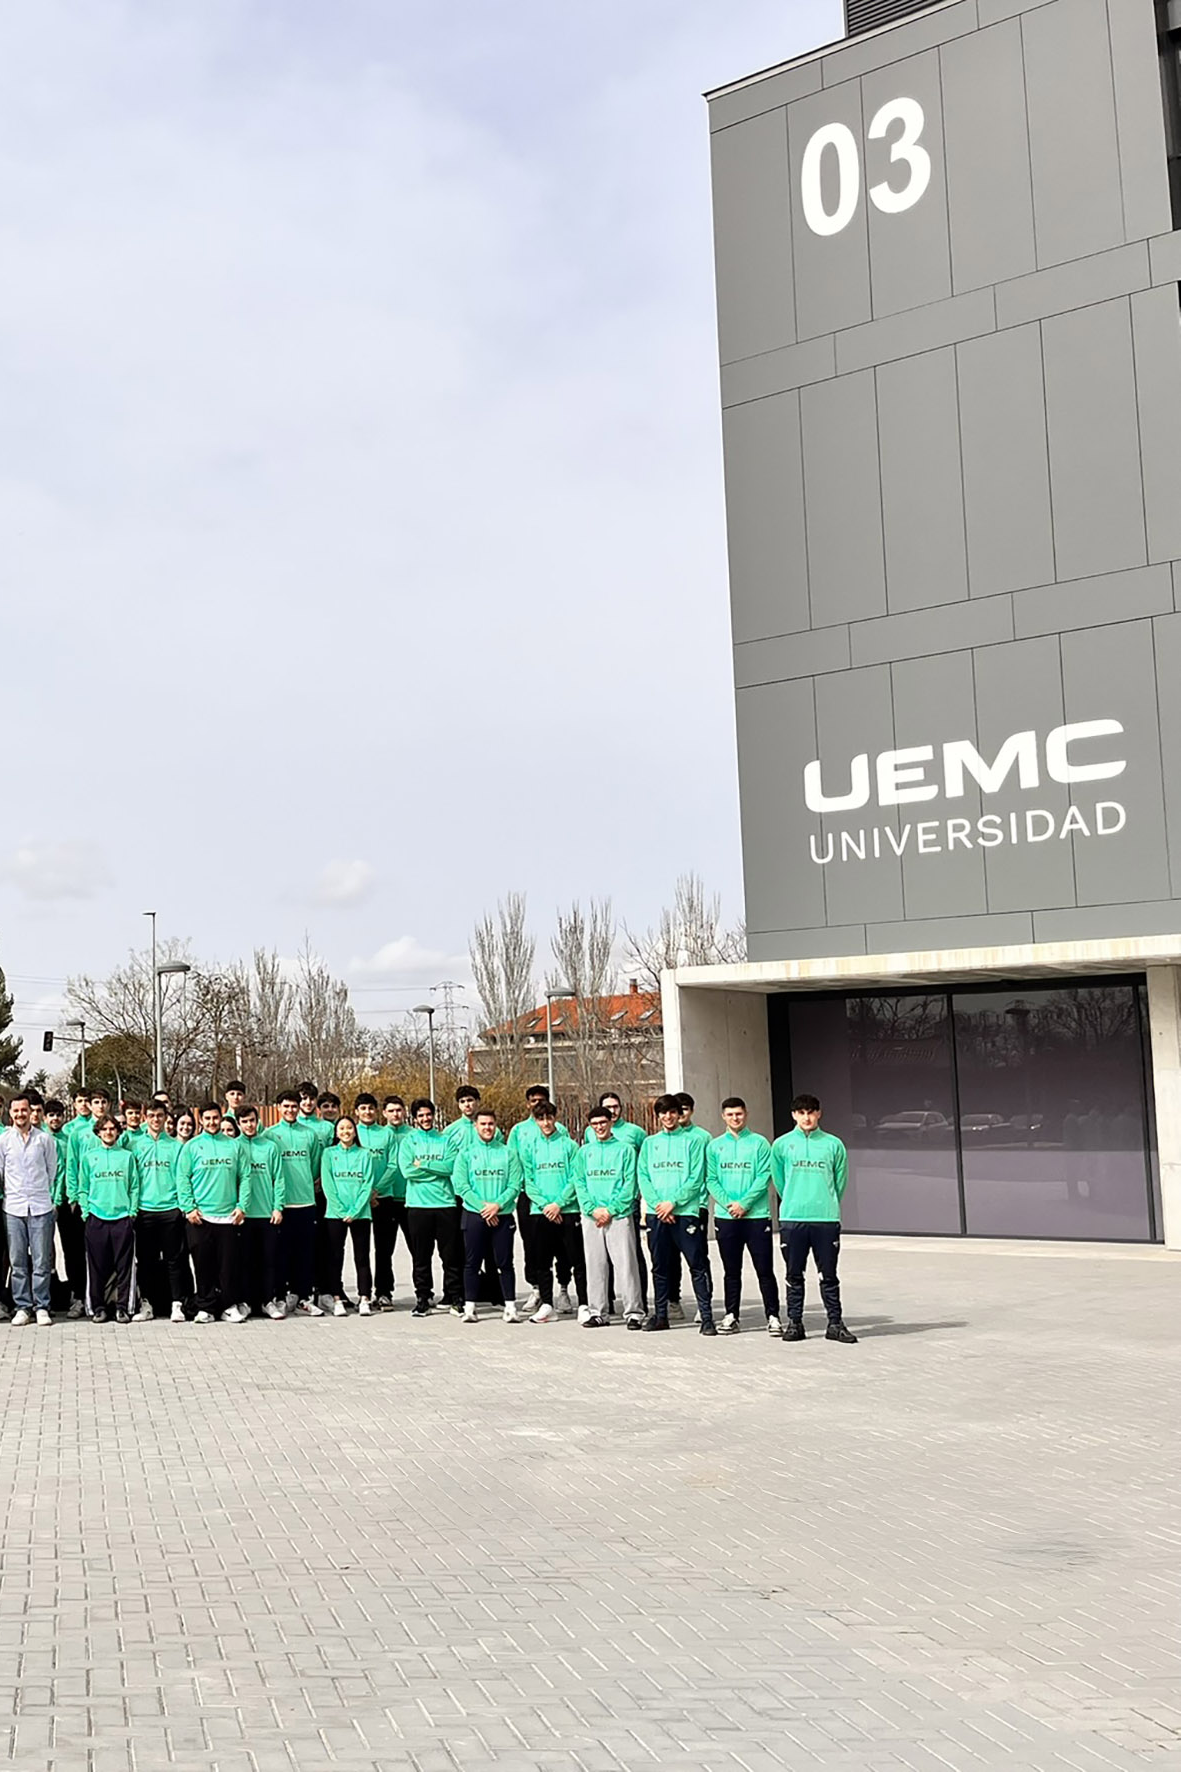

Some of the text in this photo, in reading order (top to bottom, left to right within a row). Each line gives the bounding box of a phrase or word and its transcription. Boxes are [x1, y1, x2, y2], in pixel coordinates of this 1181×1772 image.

[801, 97, 931, 237] 03
[804, 719, 1127, 813] UEMC
[810, 801, 1127, 864] UNIVERSIDAD
[201, 1158, 232, 1166] UEMC
[250, 1162, 267, 1170] MC
[652, 1161, 685, 1169] UEMC
[94, 1170, 124, 1178] UEMC
[586, 1169, 617, 1177] UEMC
